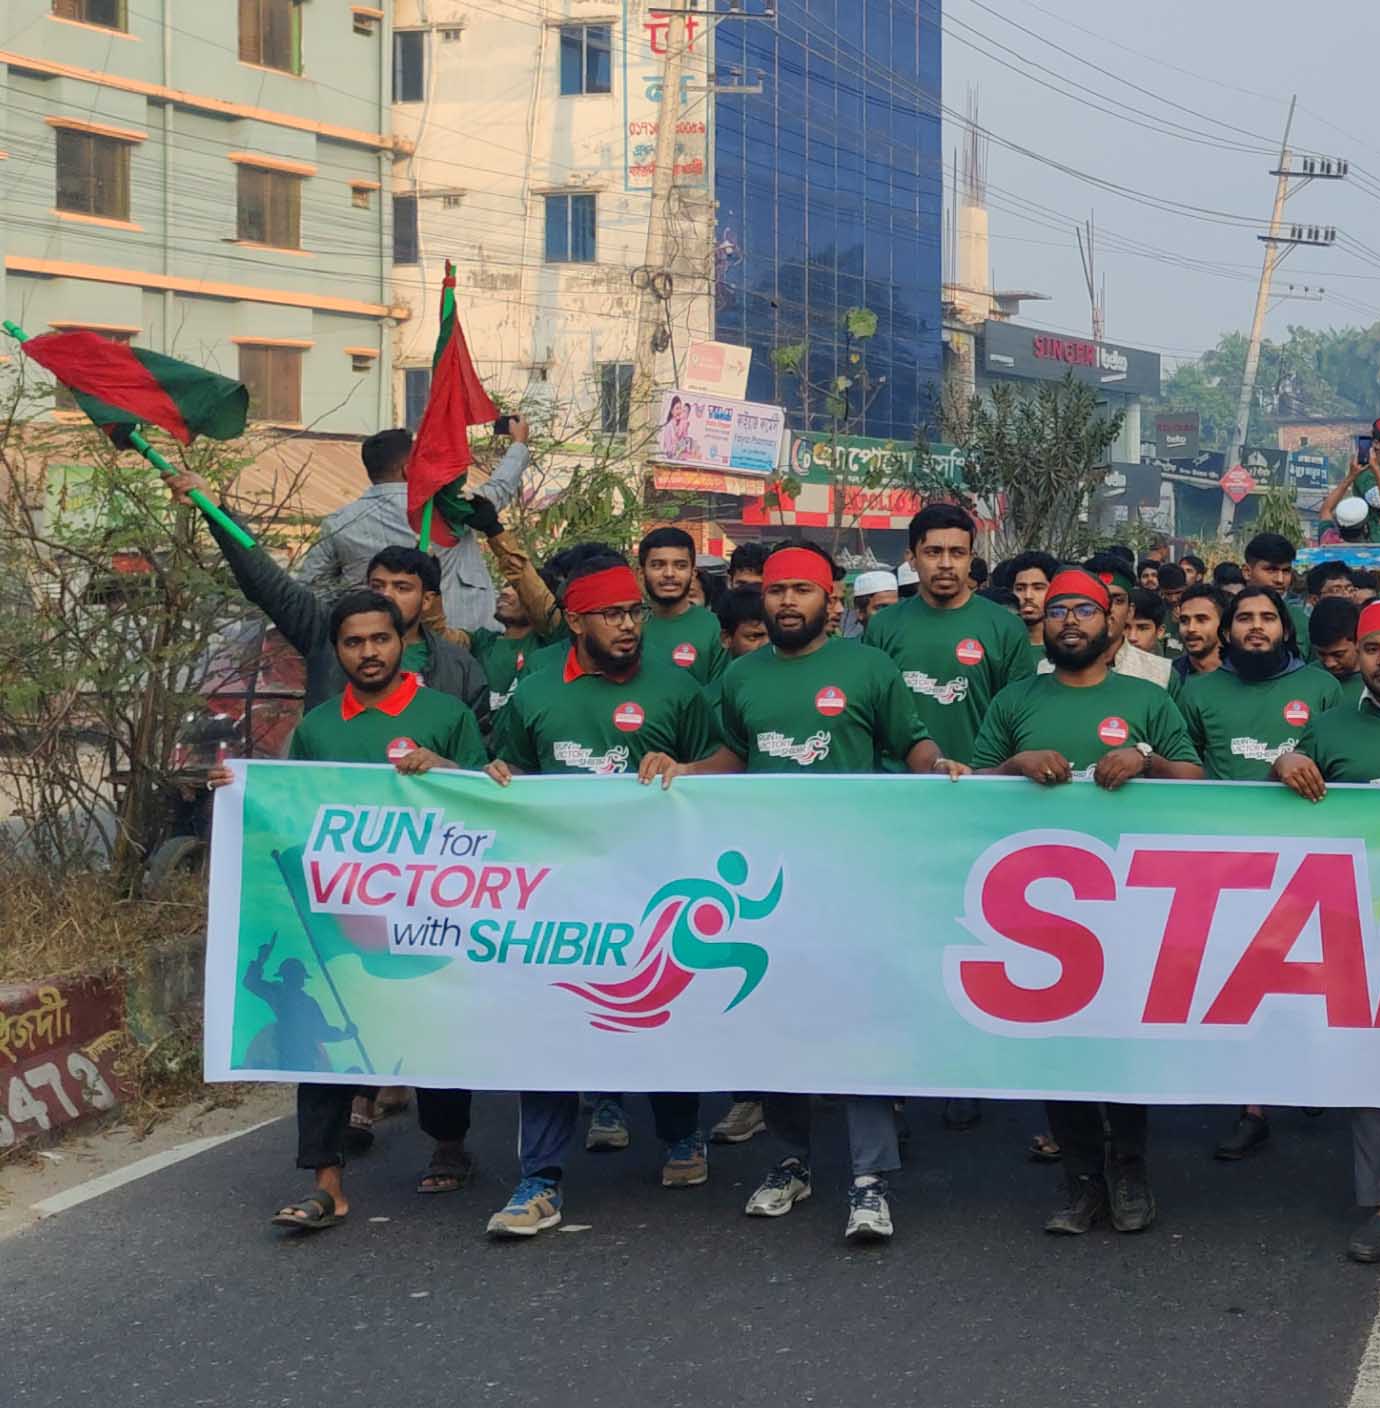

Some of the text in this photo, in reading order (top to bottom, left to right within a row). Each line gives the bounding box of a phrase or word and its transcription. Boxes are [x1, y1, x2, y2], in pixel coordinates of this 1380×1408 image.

[1033, 335, 1095, 367] SINGER
[313, 807, 490, 858] RUN for
[308, 862, 552, 912] VICTORY
[392, 916, 635, 967] with SHIBIR
